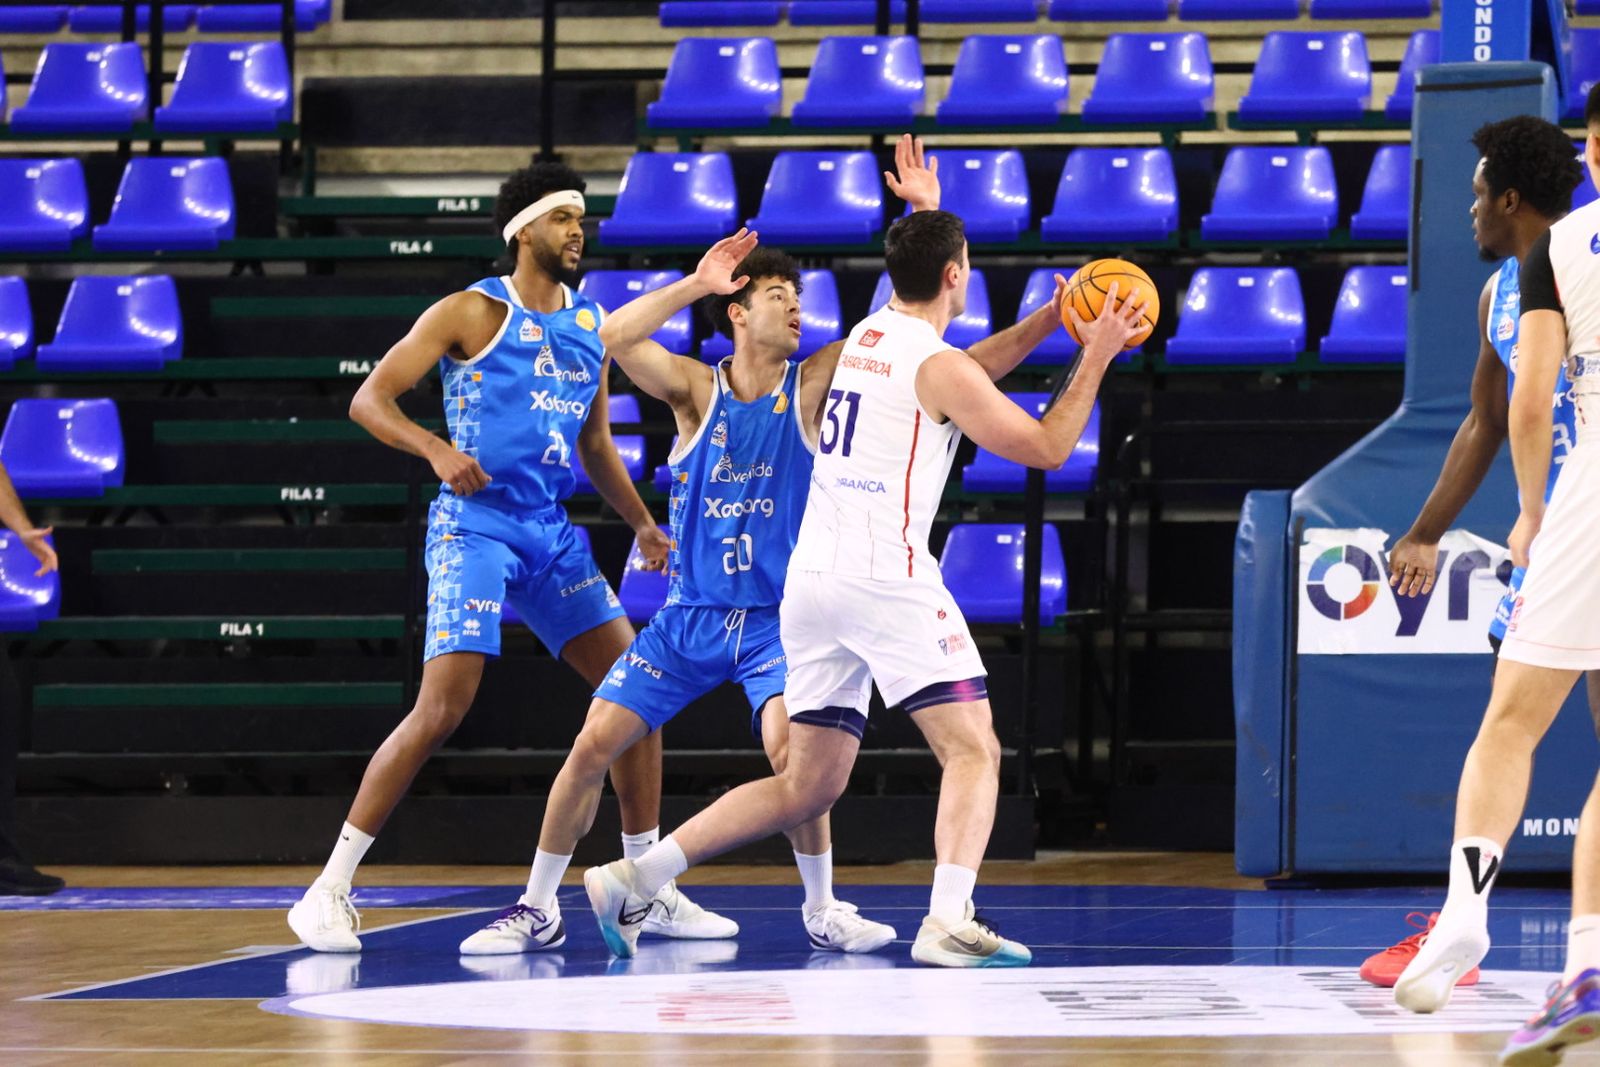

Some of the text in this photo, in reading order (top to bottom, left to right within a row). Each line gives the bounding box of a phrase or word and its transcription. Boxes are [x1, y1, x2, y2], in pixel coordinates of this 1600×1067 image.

[437, 199, 480, 211] FILA 5
[390, 241, 433, 253] FILA 4
[339, 361, 370, 373] FILA
[819, 389, 862, 458] 31
[280, 488, 325, 500] FILA 2
[721, 533, 753, 576] 20
[1306, 544, 1512, 637] oyr
[220, 623, 264, 636] FILA 1
